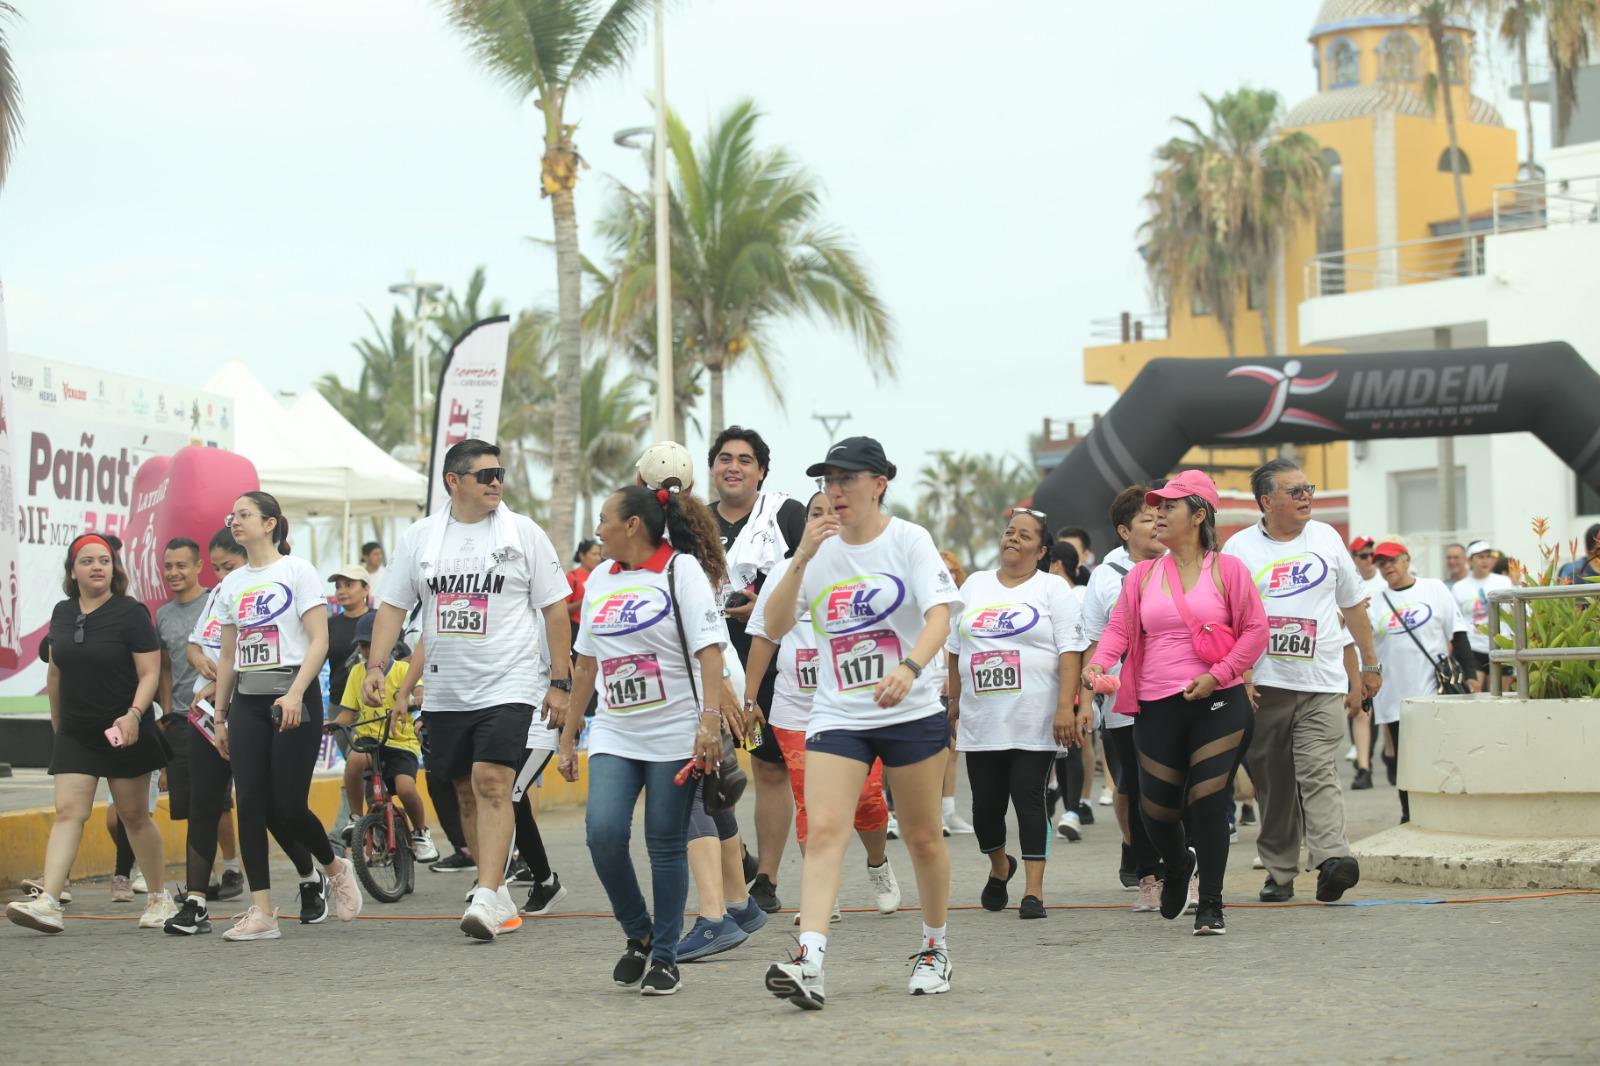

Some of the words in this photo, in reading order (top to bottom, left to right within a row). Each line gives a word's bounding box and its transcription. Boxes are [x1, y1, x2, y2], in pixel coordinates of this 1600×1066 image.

[1346, 363, 1509, 409] IMDEM
[444, 398, 469, 448] IF
[1345, 409, 1391, 420] INSTITUTO
[1392, 406, 1441, 418] MUNICIPAL
[1442, 405, 1458, 415] DEL
[1459, 403, 1500, 414] DEPORTE
[1269, 563, 1313, 588] 5K
[238, 593, 276, 619] 5K
[592, 600, 651, 623] 5K
[827, 588, 882, 620] 5K
[440, 609, 482, 630] 1253
[971, 611, 1022, 629] 5K
[241, 643, 270, 664] 1175
[1271, 633, 1310, 654] 1264
[800, 666, 818, 685] 11
[840, 654, 884, 684] 1177
[975, 666, 1016, 688] 1289
[608, 676, 647, 705] 1147
